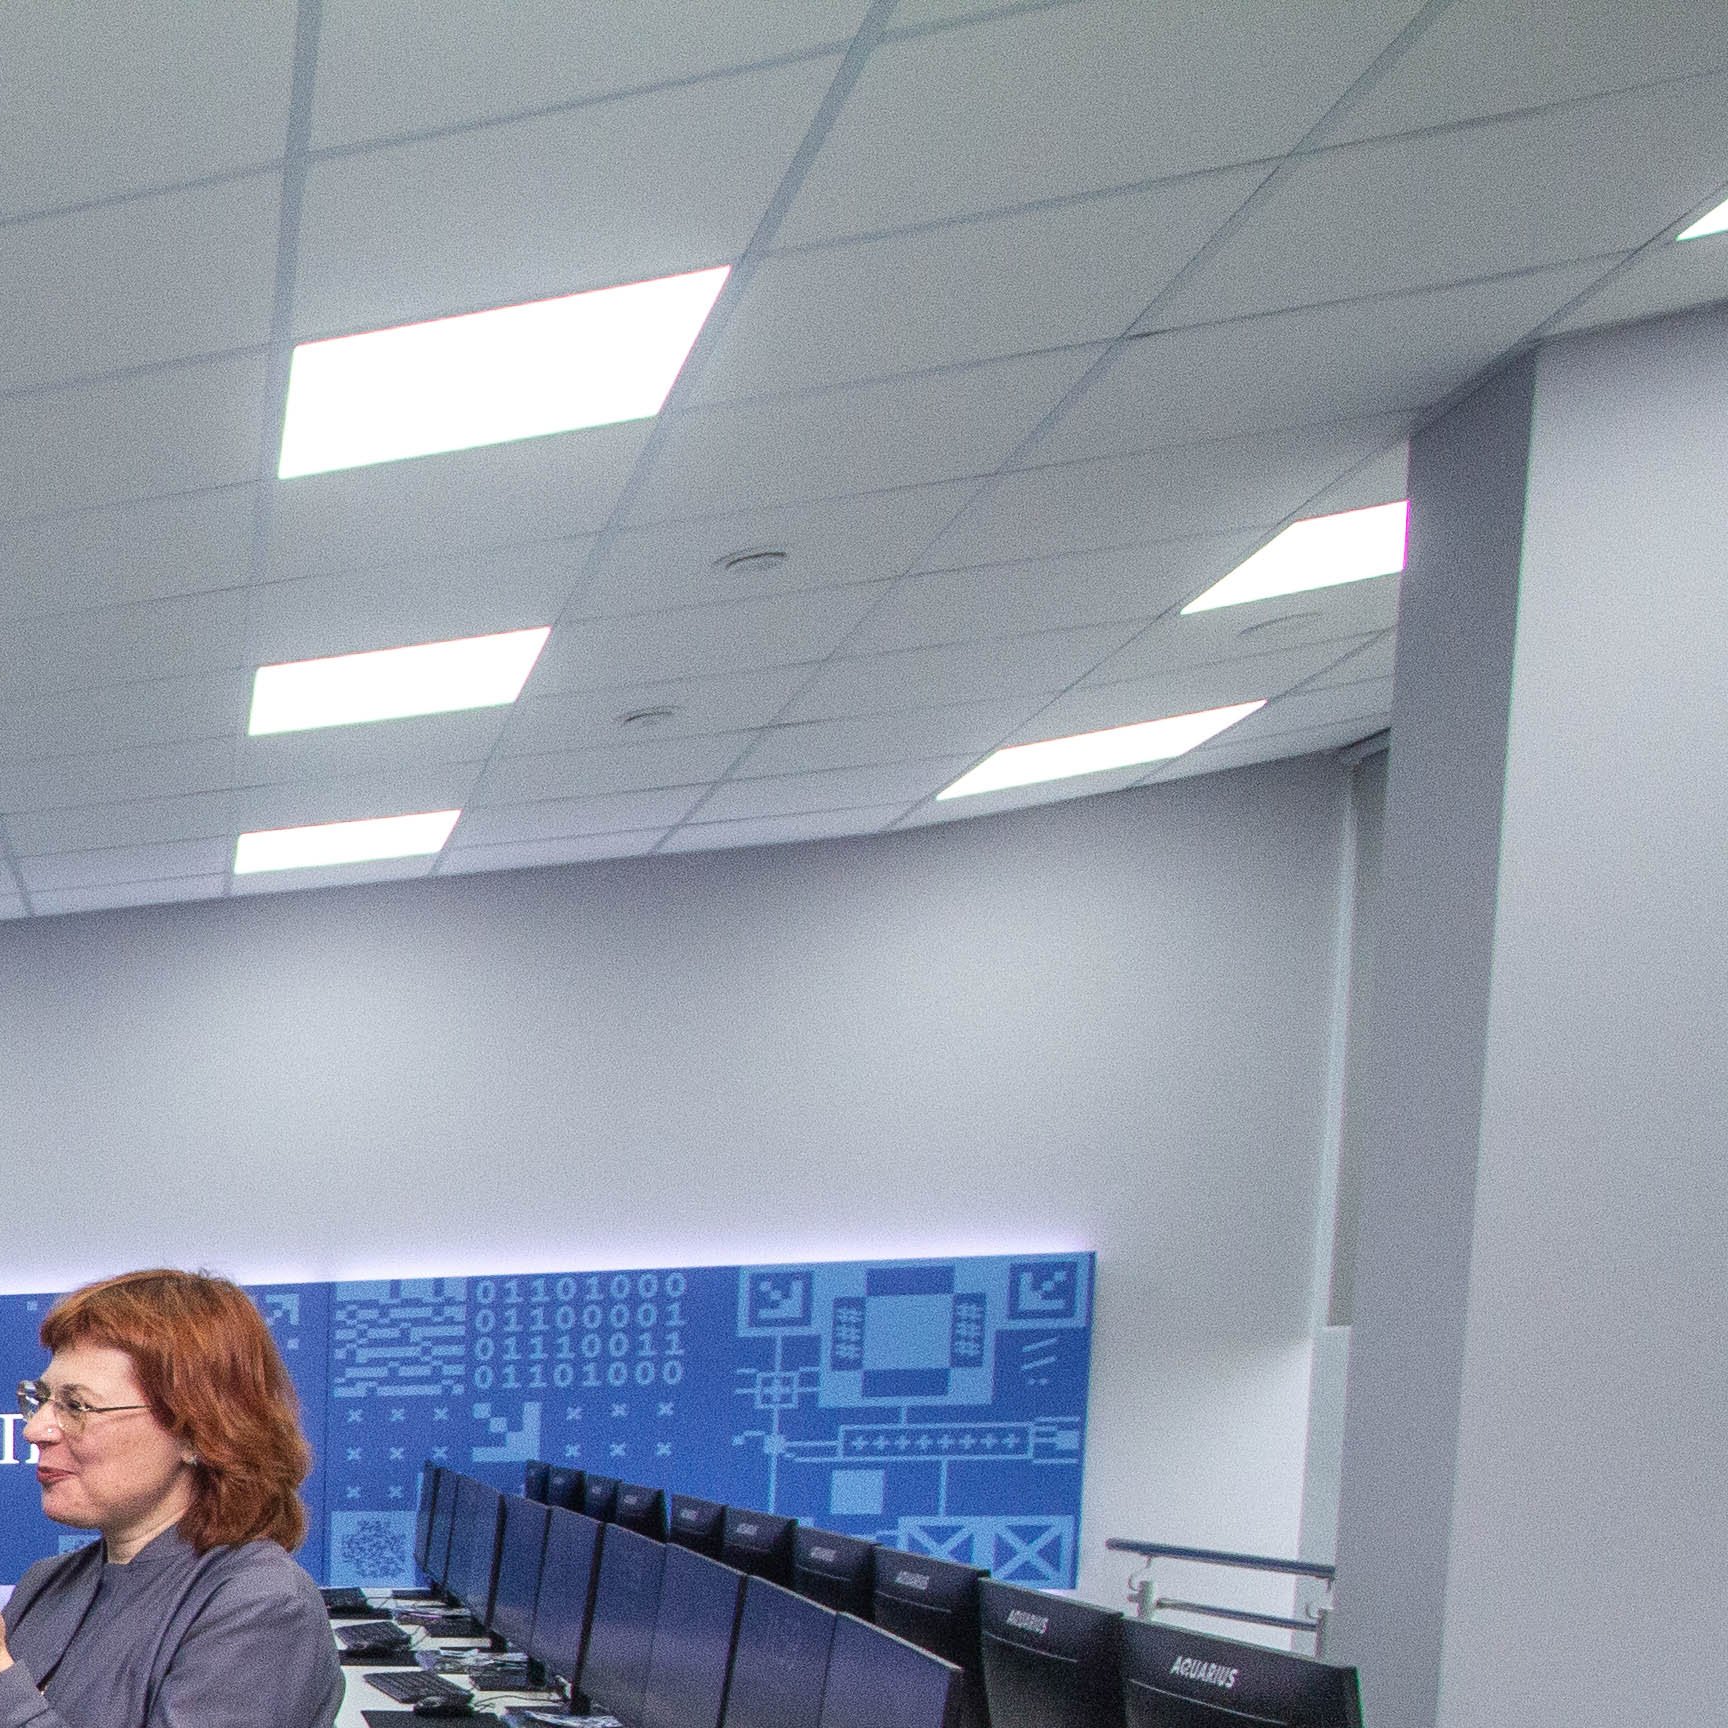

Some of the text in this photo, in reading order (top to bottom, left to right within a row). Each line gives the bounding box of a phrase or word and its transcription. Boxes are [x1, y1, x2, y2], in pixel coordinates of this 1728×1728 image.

[476, 1273, 687, 1303] 01101000
[476, 1302, 687, 1331] 01100001
[475, 1331, 684, 1359] 01110011
[474, 1361, 683, 1389] 01101000
[1169, 1655, 1239, 1688] AQUARIUS
